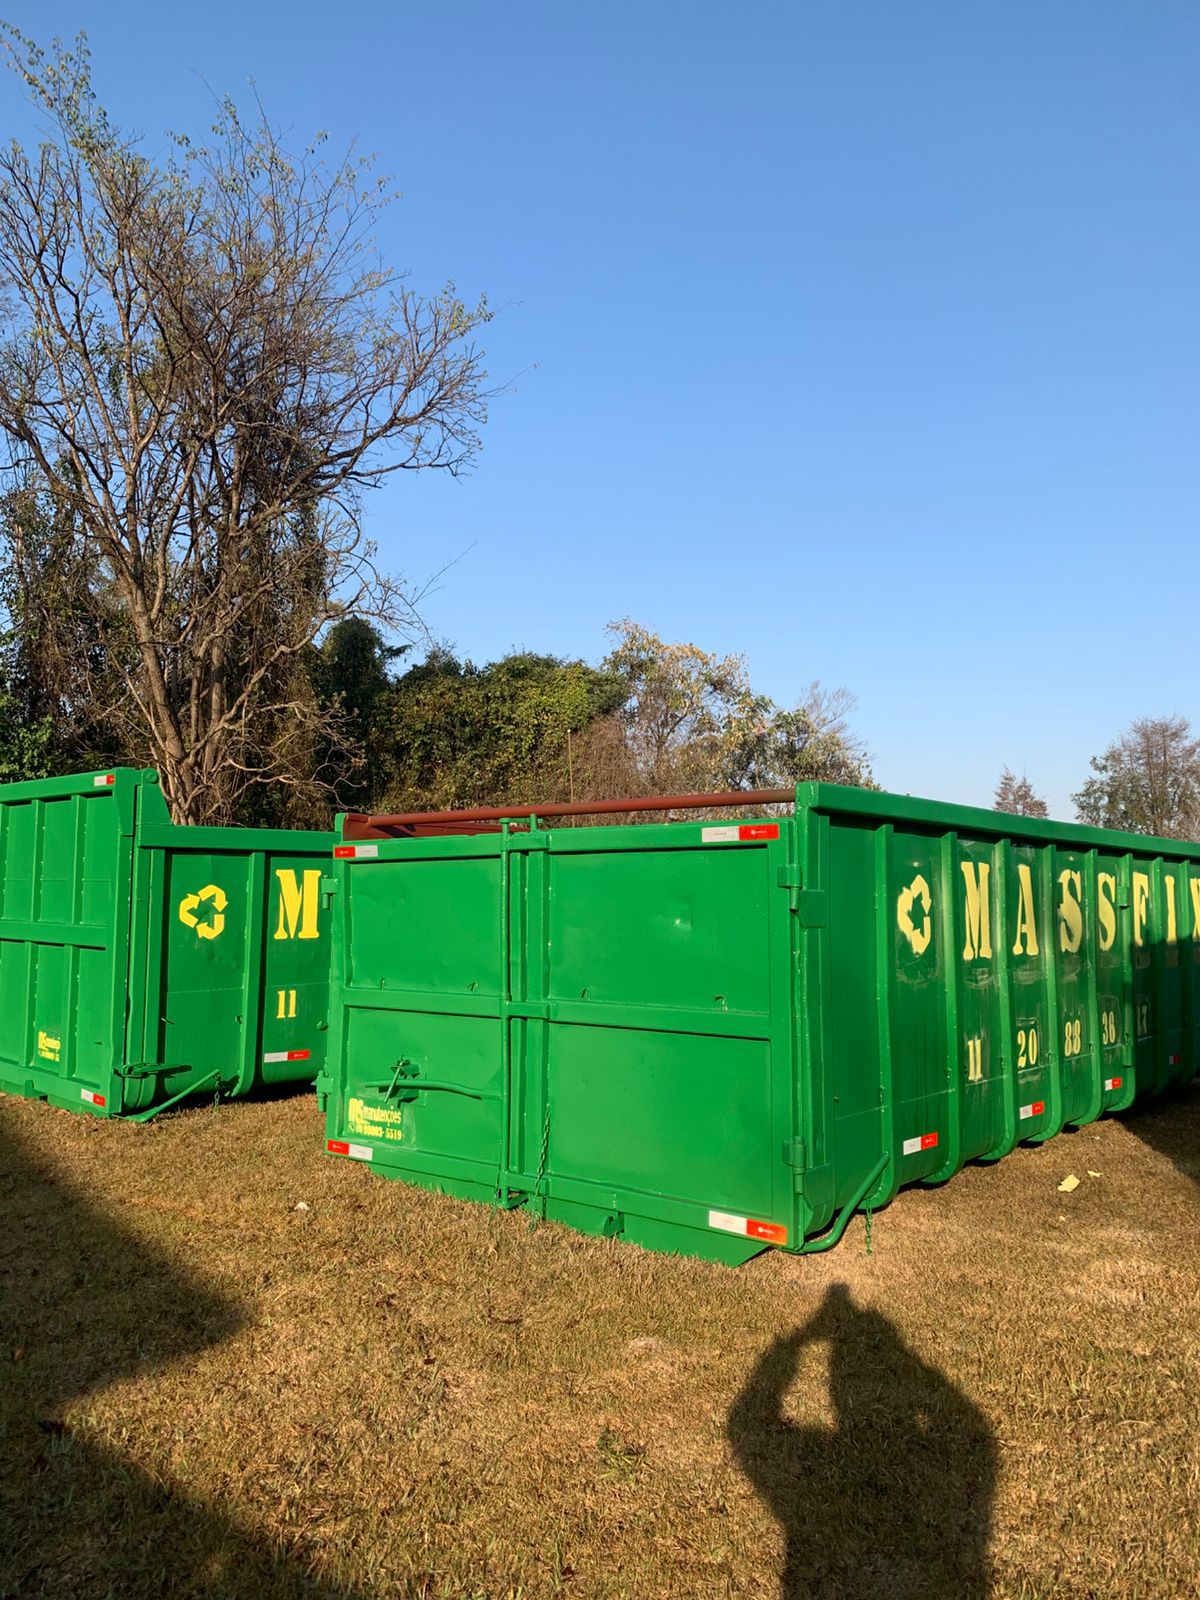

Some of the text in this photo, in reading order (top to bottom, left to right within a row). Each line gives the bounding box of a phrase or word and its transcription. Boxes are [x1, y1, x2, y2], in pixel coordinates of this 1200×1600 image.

[274, 868, 322, 940] M
[276, 989, 297, 1019] 11
[967, 1038, 983, 1082] 11
[1017, 1028, 1038, 1068] 20
[1064, 1018, 1081, 1057] 88
[1102, 1011, 1117, 1045] 36
[386, 1128, 402, 1141] 5519
